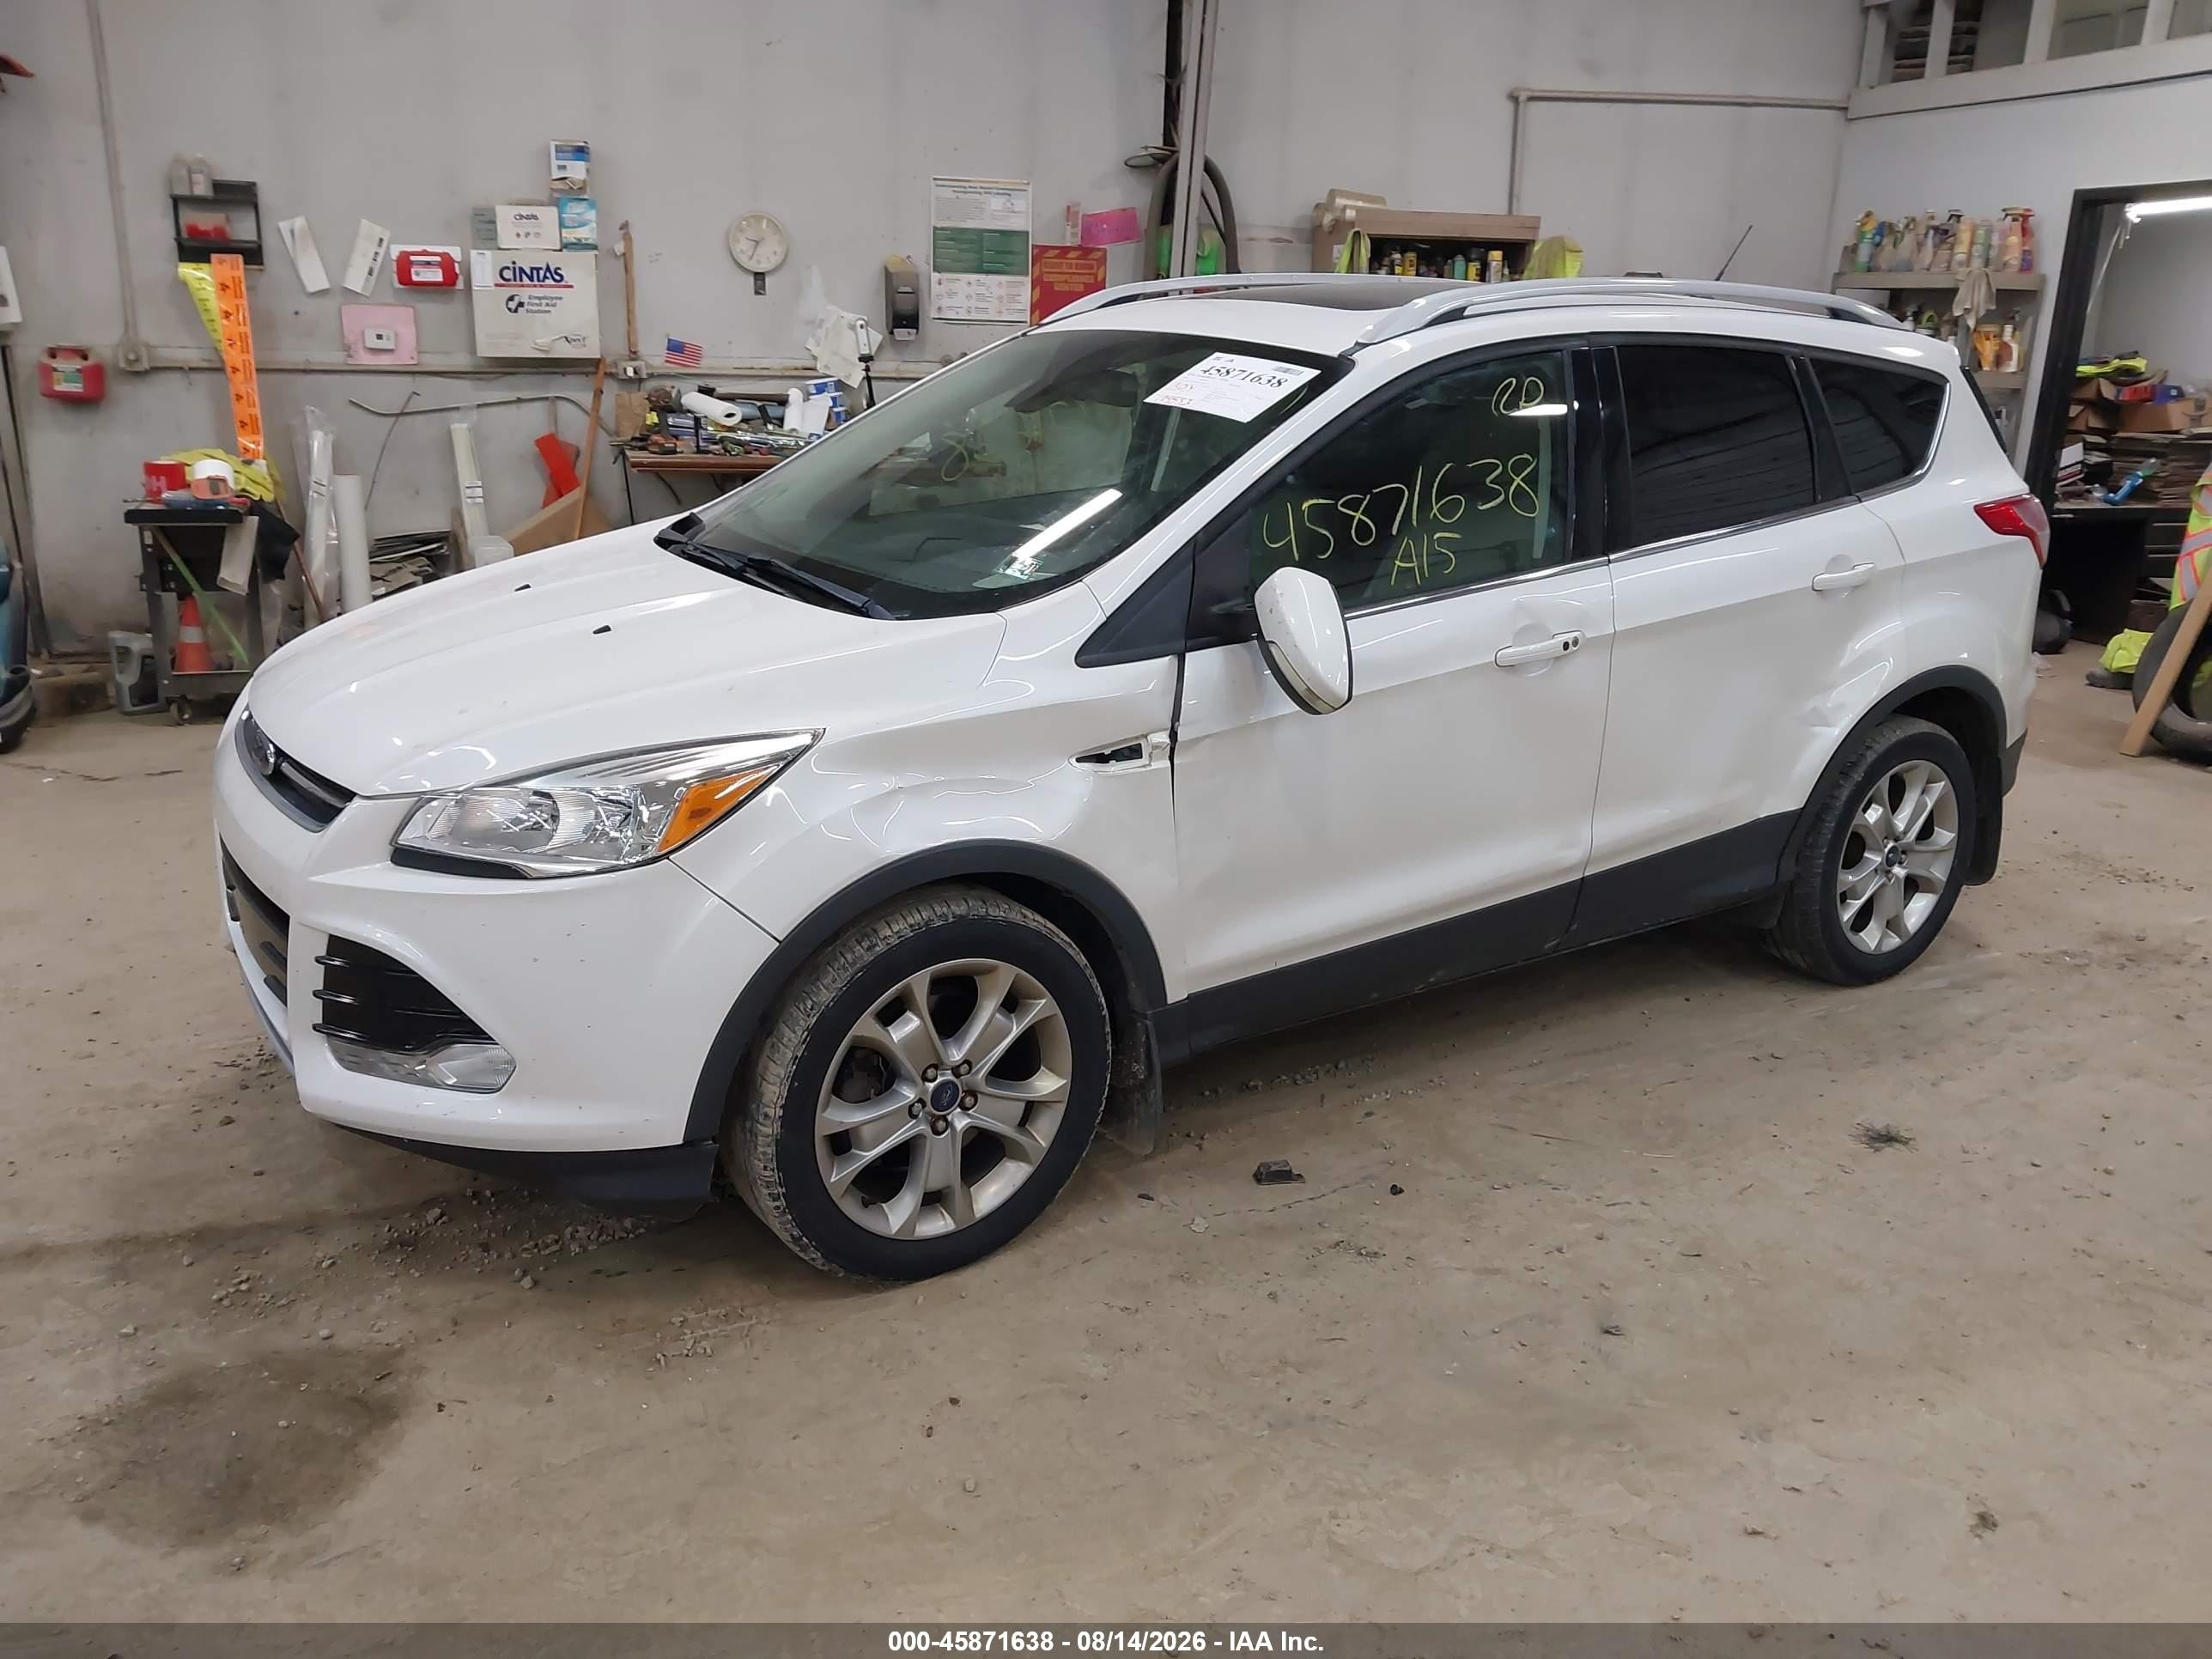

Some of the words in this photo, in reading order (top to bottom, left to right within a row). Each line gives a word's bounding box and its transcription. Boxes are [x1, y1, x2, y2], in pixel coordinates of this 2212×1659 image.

[1200, 365, 1288, 388] 45871638
[1264, 453, 1540, 561] 45871638
[1391, 532, 1462, 586] A15
